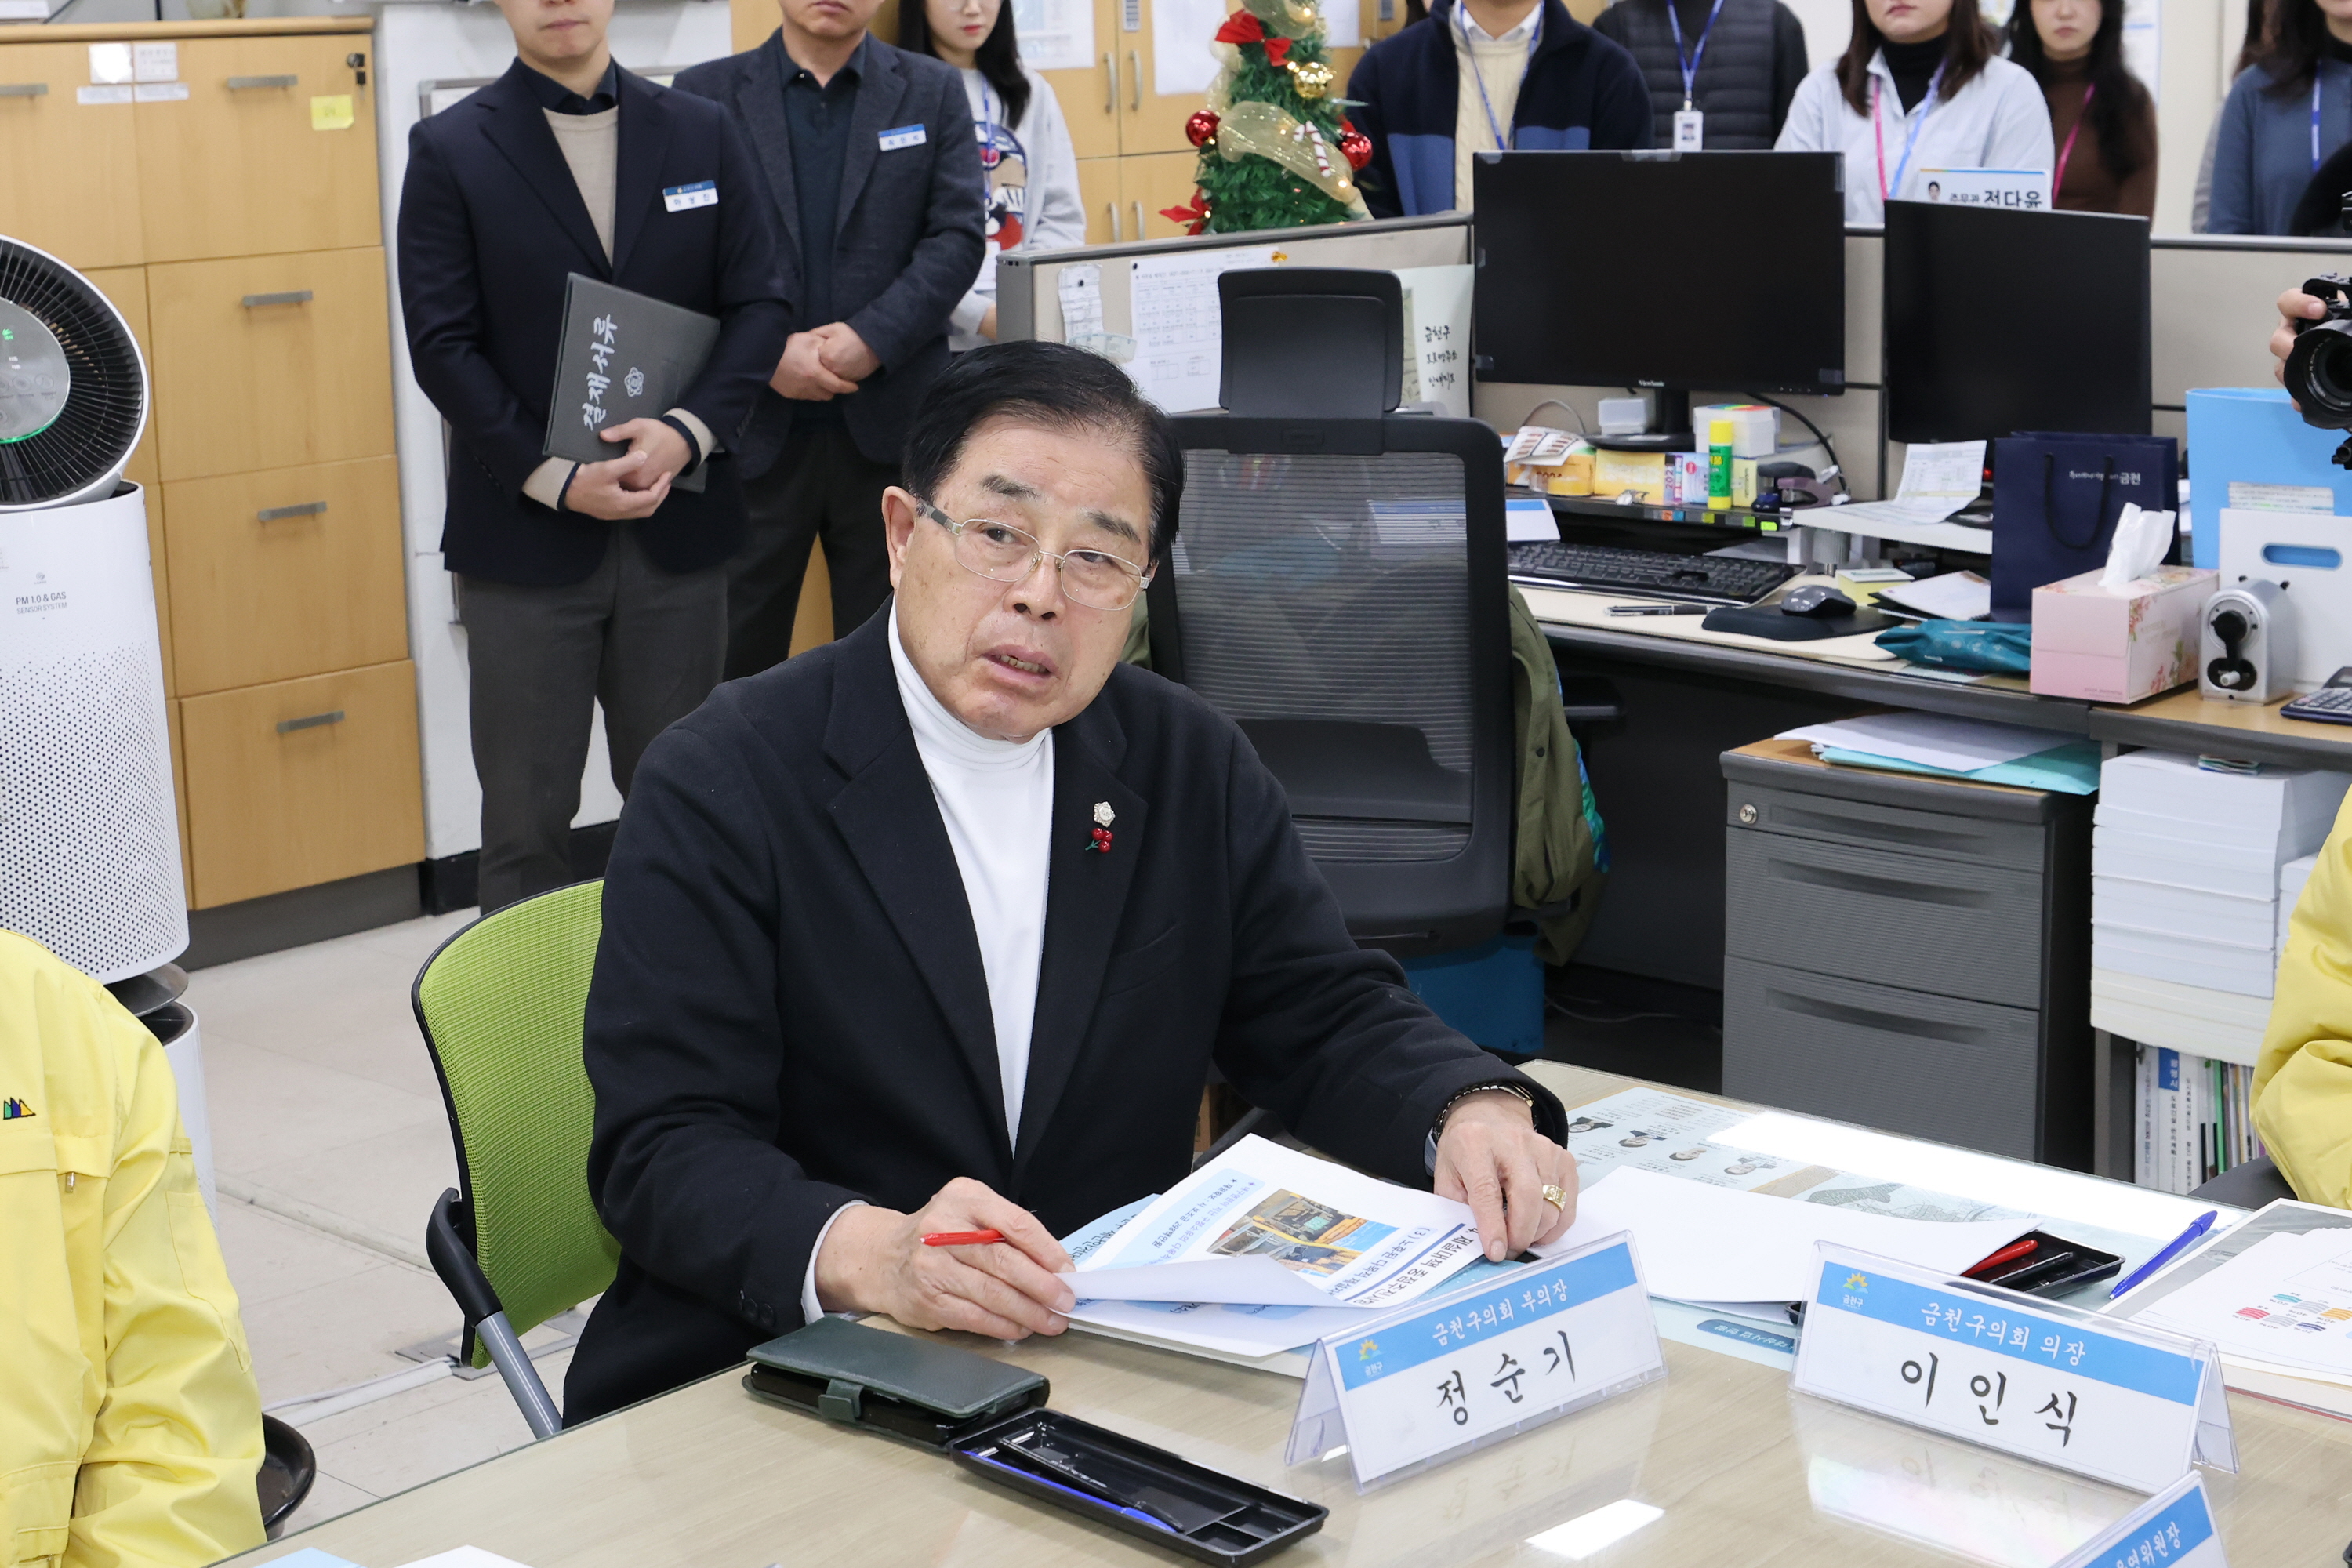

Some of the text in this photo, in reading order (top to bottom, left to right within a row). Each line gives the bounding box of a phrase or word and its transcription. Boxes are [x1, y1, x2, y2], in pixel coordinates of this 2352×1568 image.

[1425, 325, 1450, 343] 금천구
[582, 314, 618, 432] 결재서류
[16, 597, 29, 605] PM
[31, 594, 42, 604] 1.0
[50, 591, 67, 601] GAS
[16, 602, 67, 614] SENSOR SYSTEM
[1381, 1239, 1414, 1259] 노후된
[1421, 1233, 1475, 1268] 제설대책
[1354, 1259, 1388, 1279] 다목적
[1843, 1294, 1864, 1308] 금천구
[1433, 1278, 1568, 1348] 금천구의회 부의장
[1740, 1332, 1788, 1348] 대상사업
[1921, 1302, 2086, 1367] 금천구의회 의장
